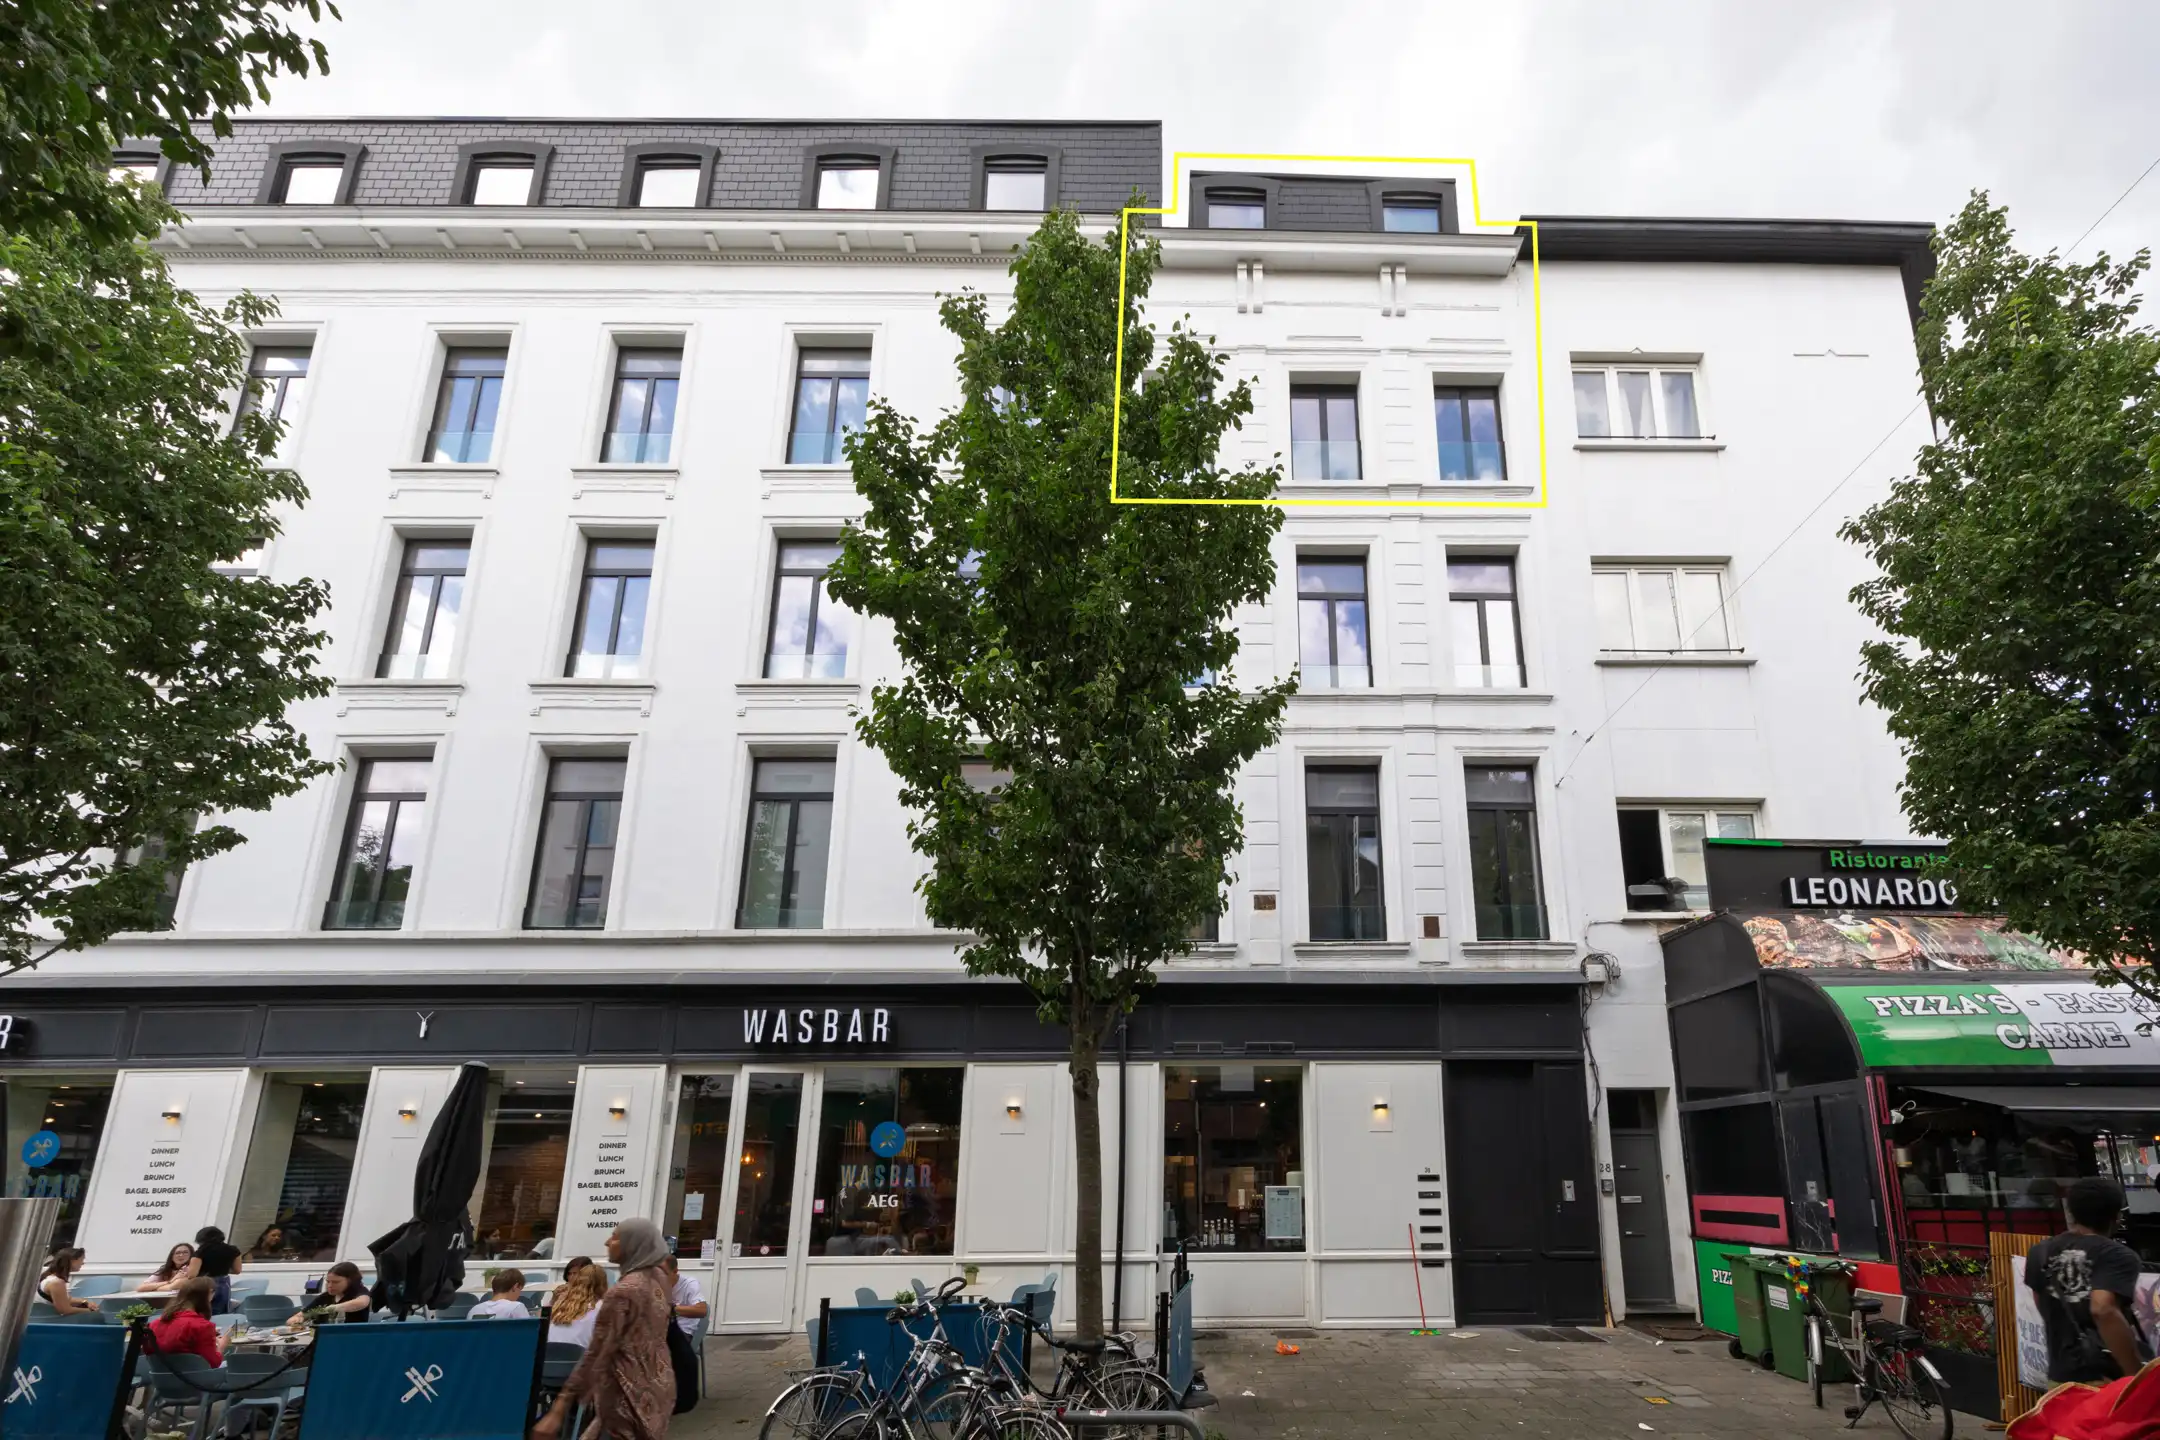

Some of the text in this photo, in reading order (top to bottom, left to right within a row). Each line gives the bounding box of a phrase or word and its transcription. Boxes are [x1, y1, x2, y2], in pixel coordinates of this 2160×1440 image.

[1864, 992, 2021, 1017] PIZZA'S
[743, 1008, 889, 1043] WASBAR
[1995, 1021, 2131, 1050] CARNE
[840, 1164, 932, 1188] WASBAR
[1599, 1163, 1612, 1173] 28
[867, 1194, 899, 1208] AEG
